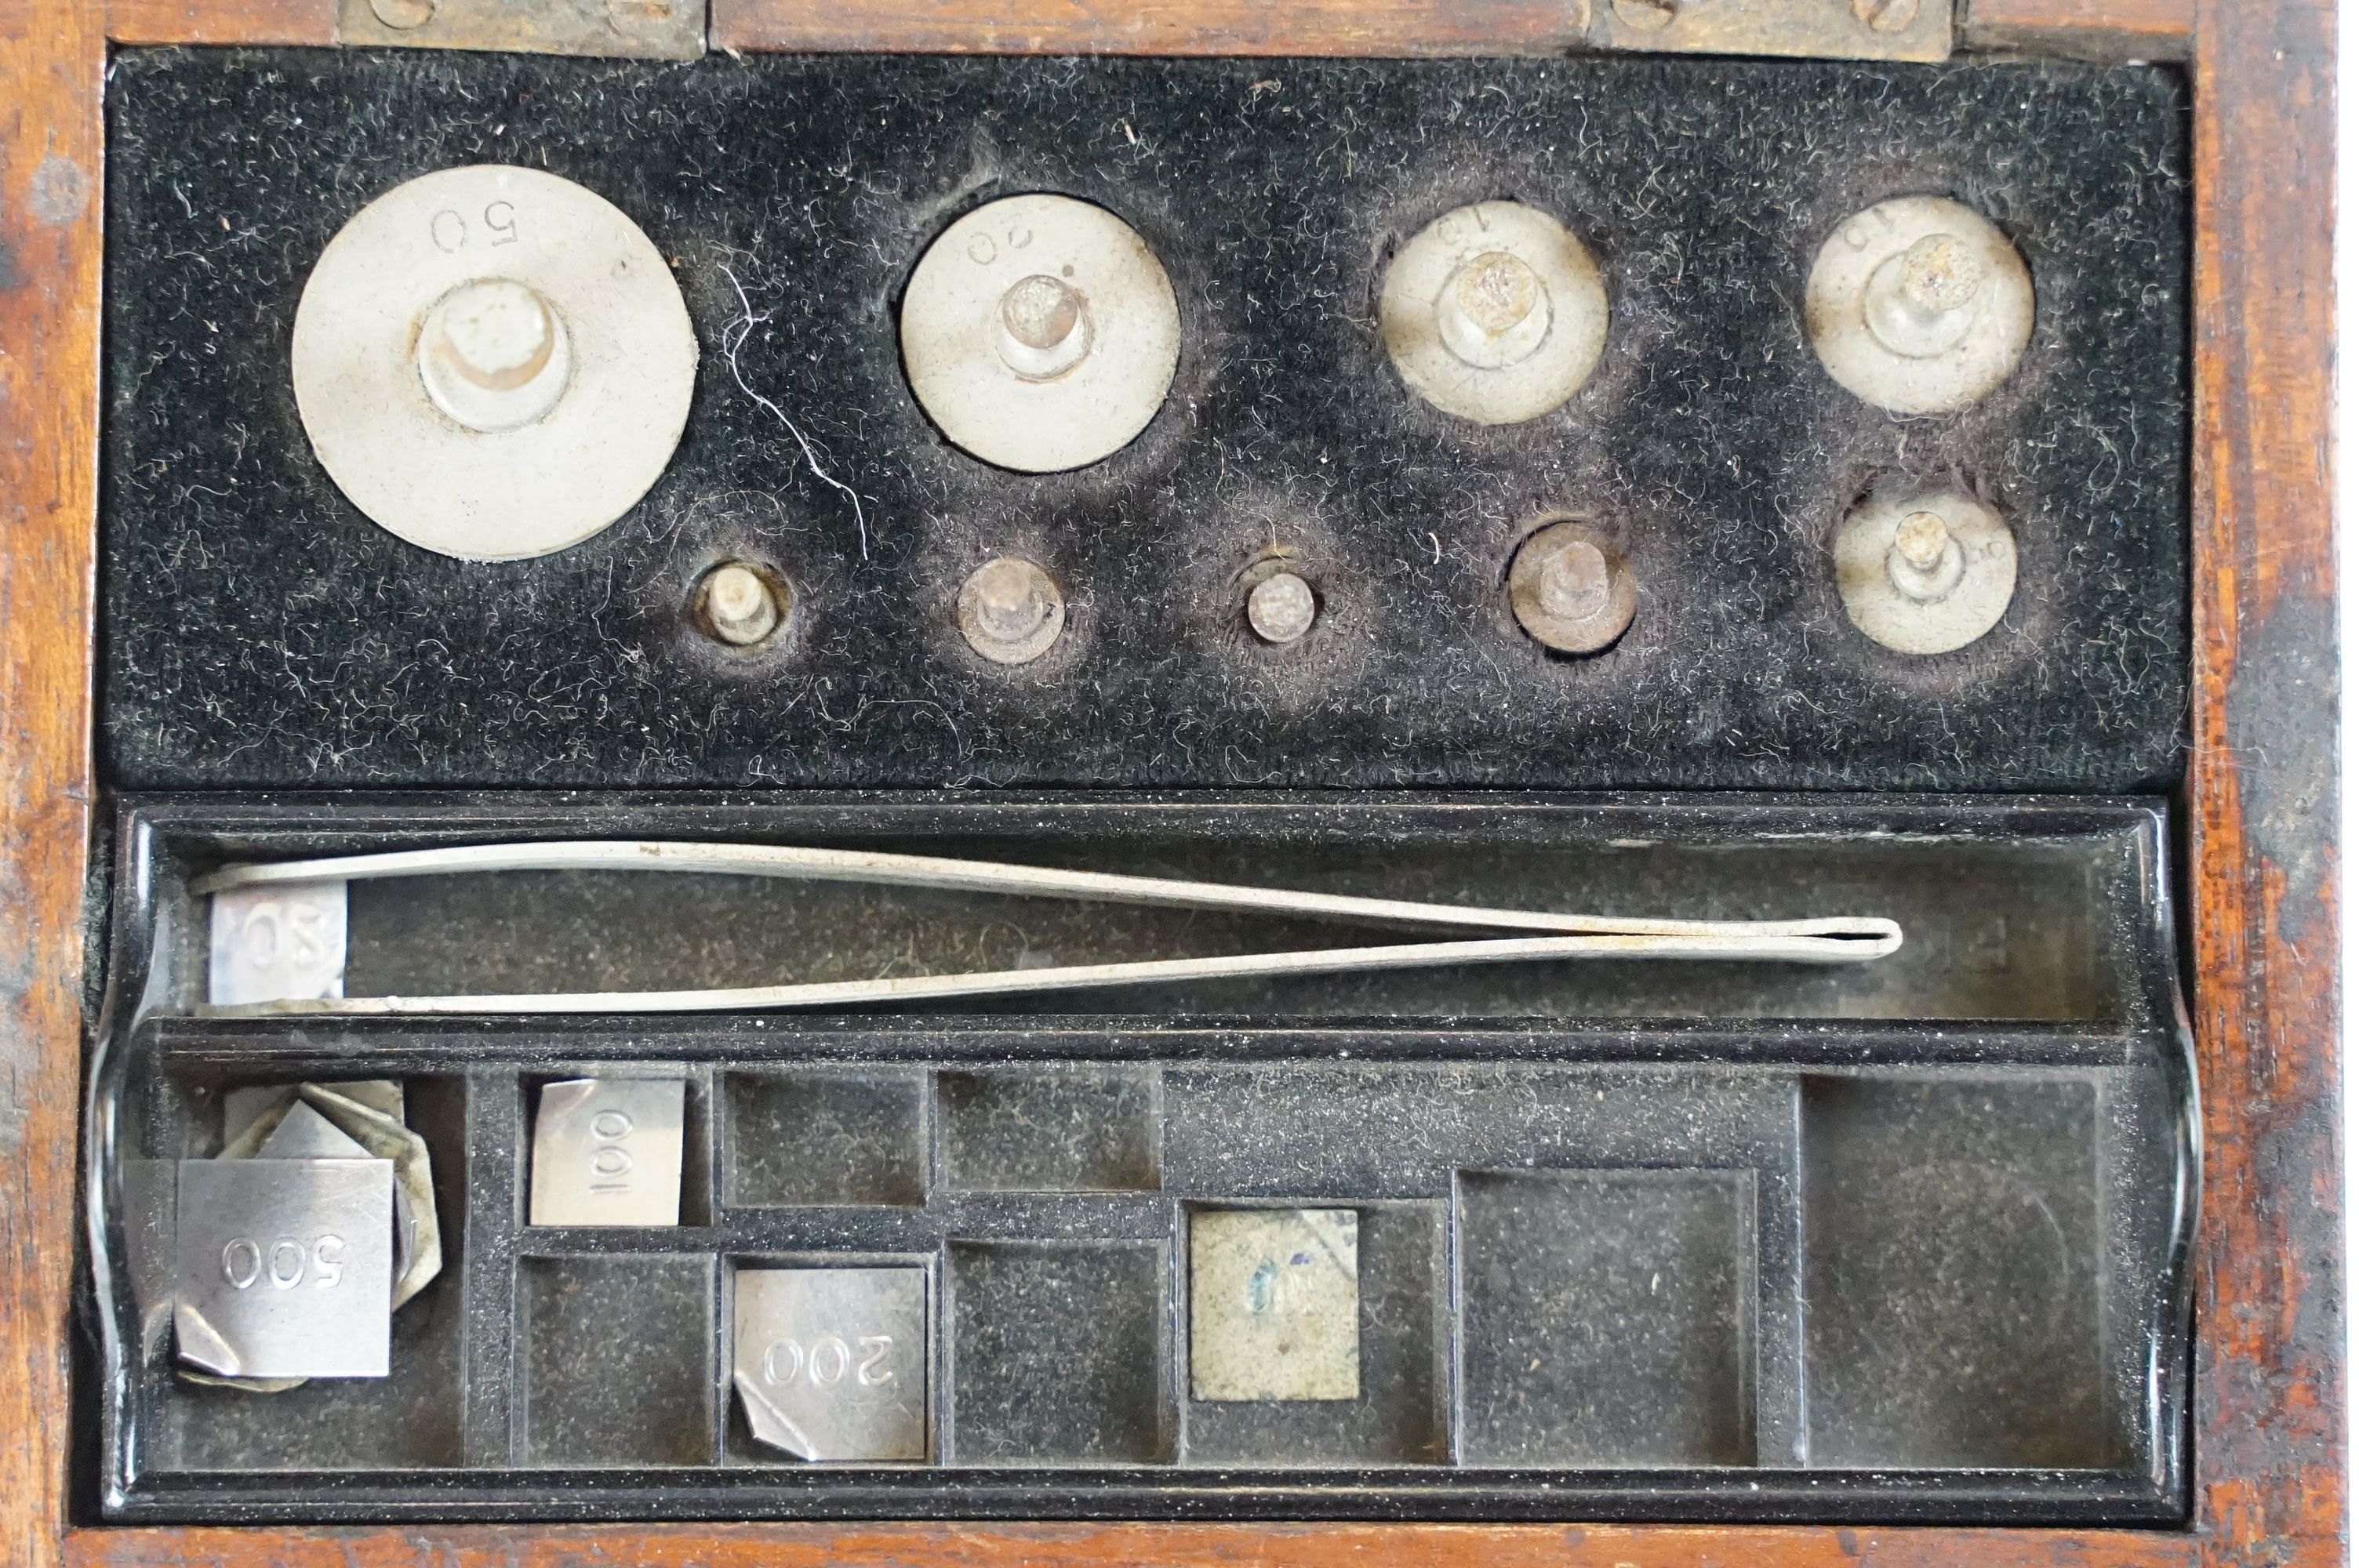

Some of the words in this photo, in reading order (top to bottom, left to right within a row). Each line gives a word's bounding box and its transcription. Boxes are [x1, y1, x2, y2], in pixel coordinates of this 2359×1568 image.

[431, 199, 518, 255] 50
[588, 1109, 634, 1194] 100
[221, 1232, 347, 1290] 500
[763, 1334, 894, 1388] 200
